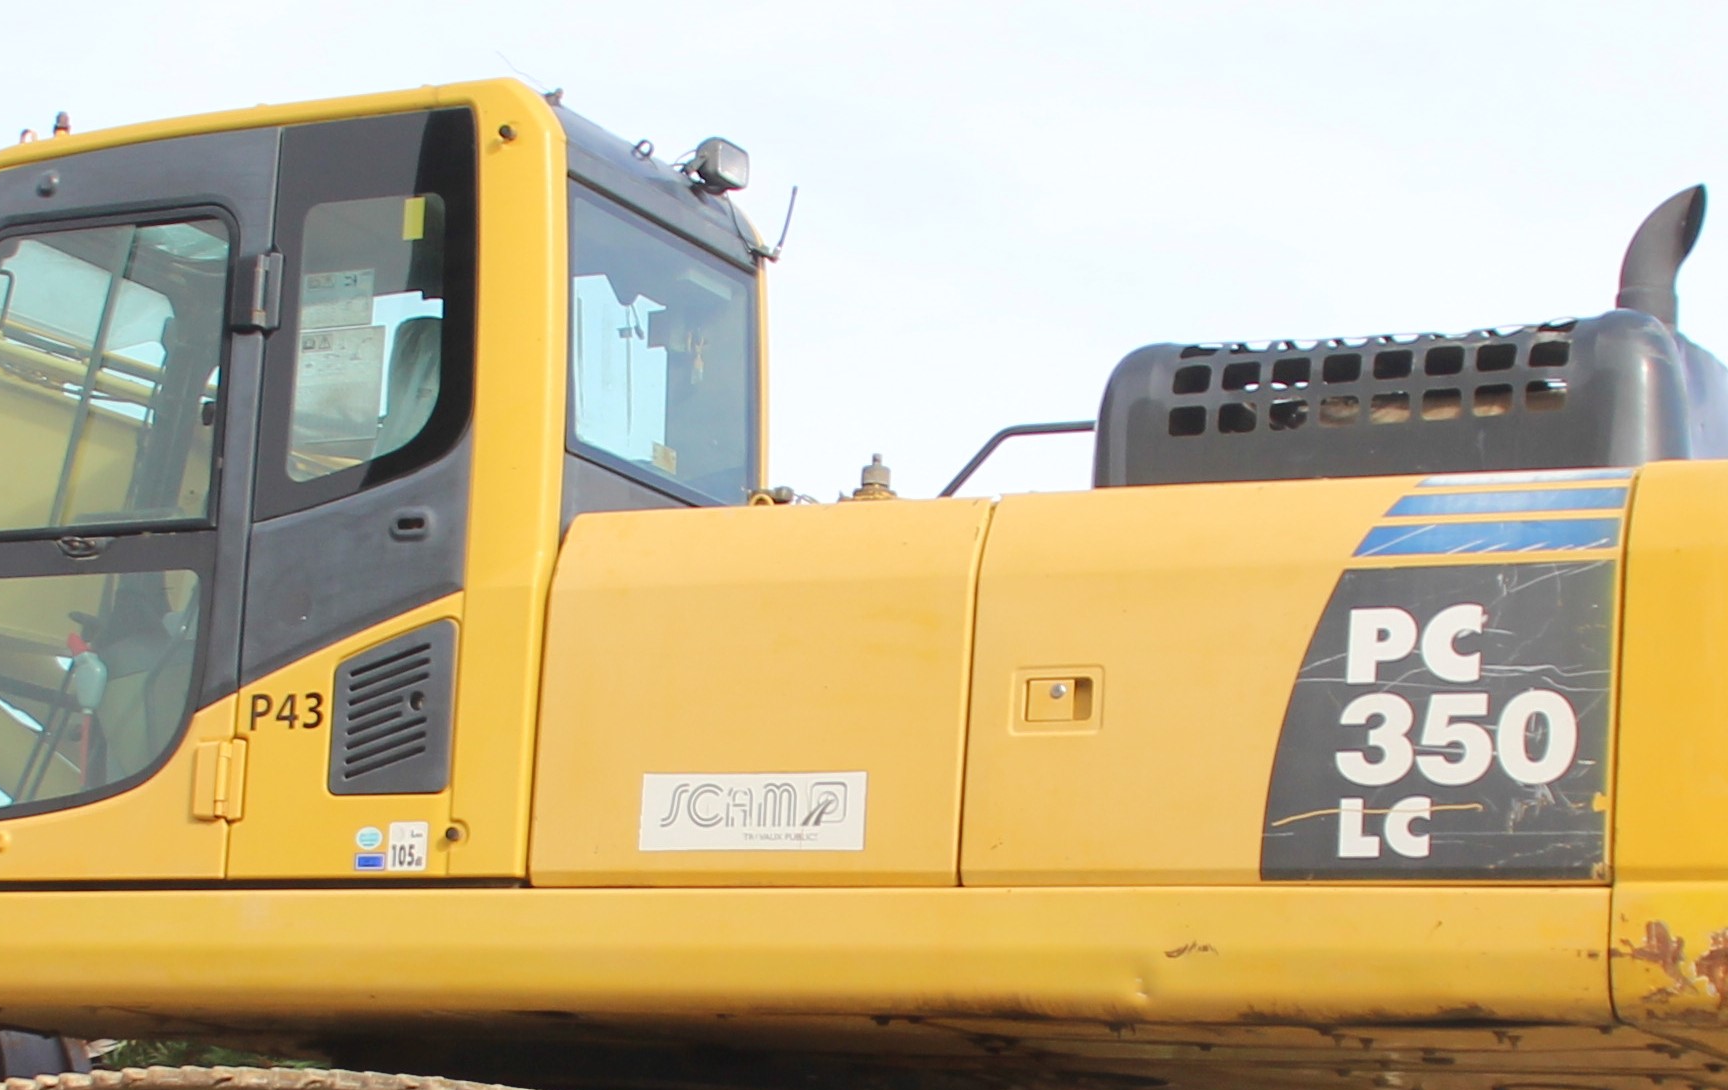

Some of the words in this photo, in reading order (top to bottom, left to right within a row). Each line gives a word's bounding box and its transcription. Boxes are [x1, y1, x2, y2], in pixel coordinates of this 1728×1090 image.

[1346, 603, 1483, 684] PC
[248, 692, 325, 731] P43
[1335, 689, 1578, 786] 350
[391, 844, 415, 867] 105
[1337, 796, 1432, 858] LC
